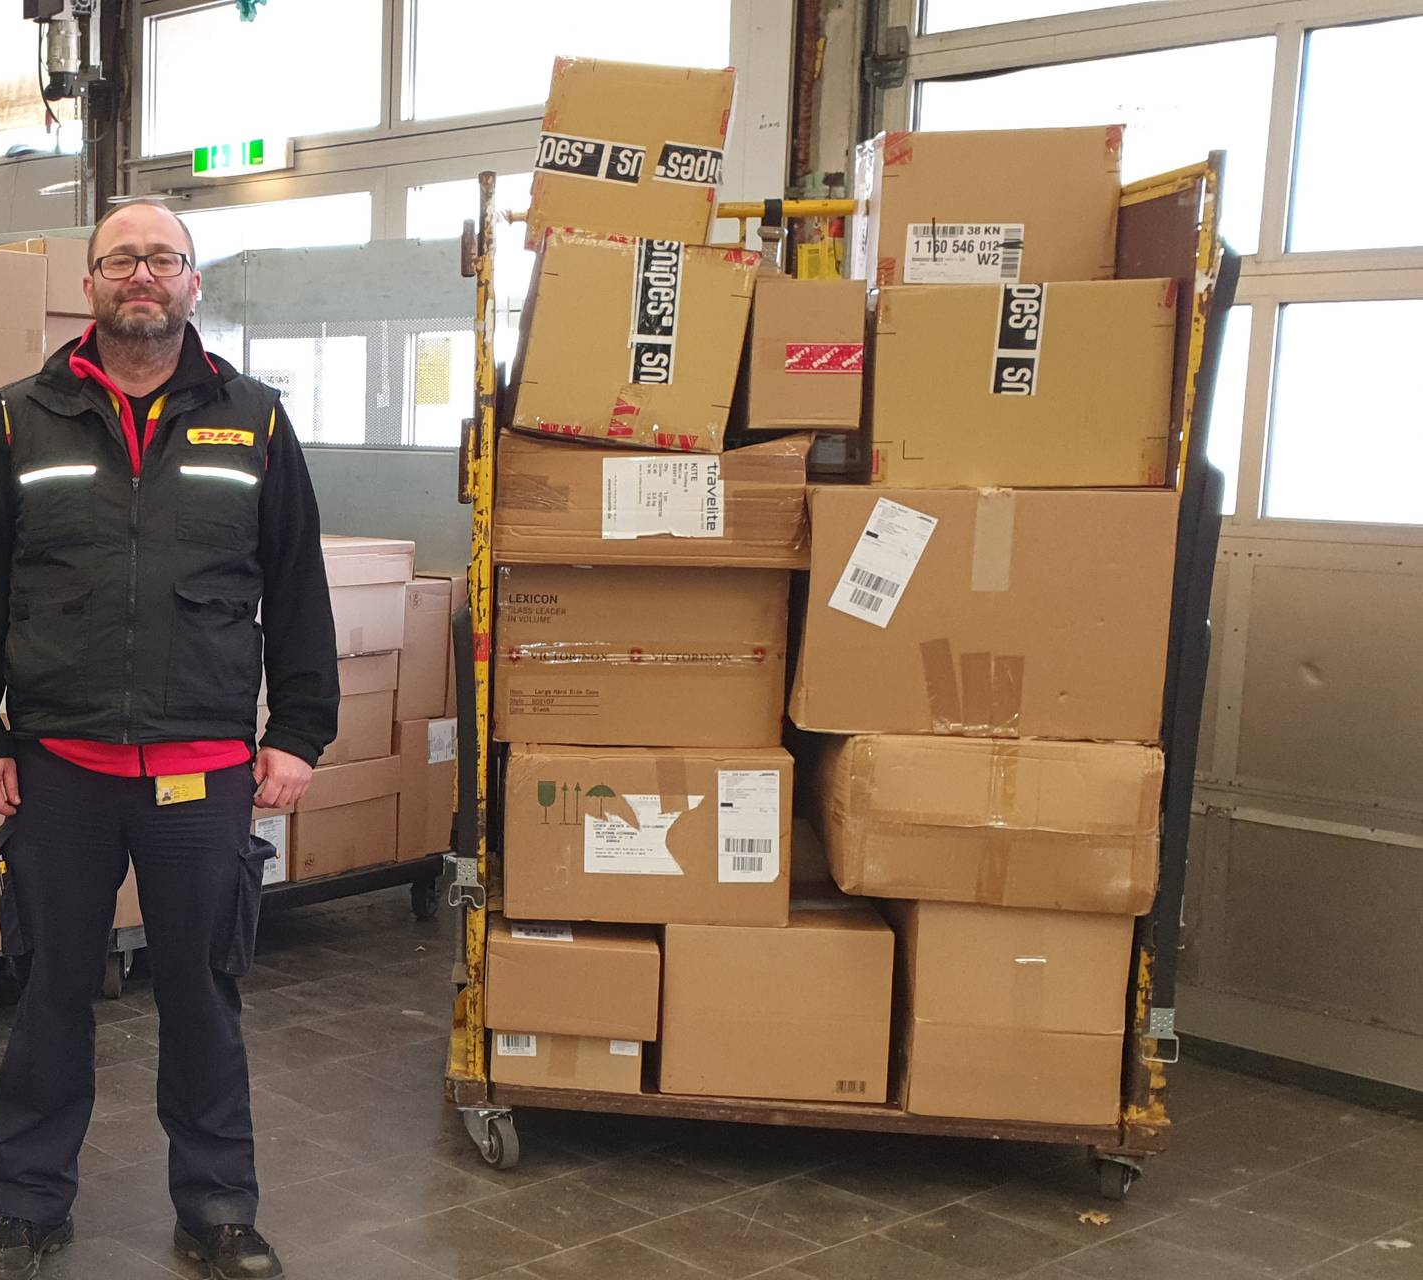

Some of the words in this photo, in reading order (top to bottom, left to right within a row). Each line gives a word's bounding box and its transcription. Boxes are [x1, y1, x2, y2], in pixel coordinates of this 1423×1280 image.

[537, 137, 584, 167] pes
[967, 226, 981, 236] 38
[984, 226, 1001, 235] KN
[914, 240, 920, 253] 1
[952, 239, 975, 254] 546
[979, 240, 998, 252] 012
[977, 253, 1000, 266] W2
[644, 239, 678, 317] snipes
[197, 431, 244, 443] DHL
[690, 462, 698, 482] KITE
[706, 461, 719, 531] travelite
[508, 593, 558, 604] LEXICON
[535, 607, 567, 615] LEADER
[507, 615, 516, 623] IN
[518, 616, 552, 624] VOLUME
